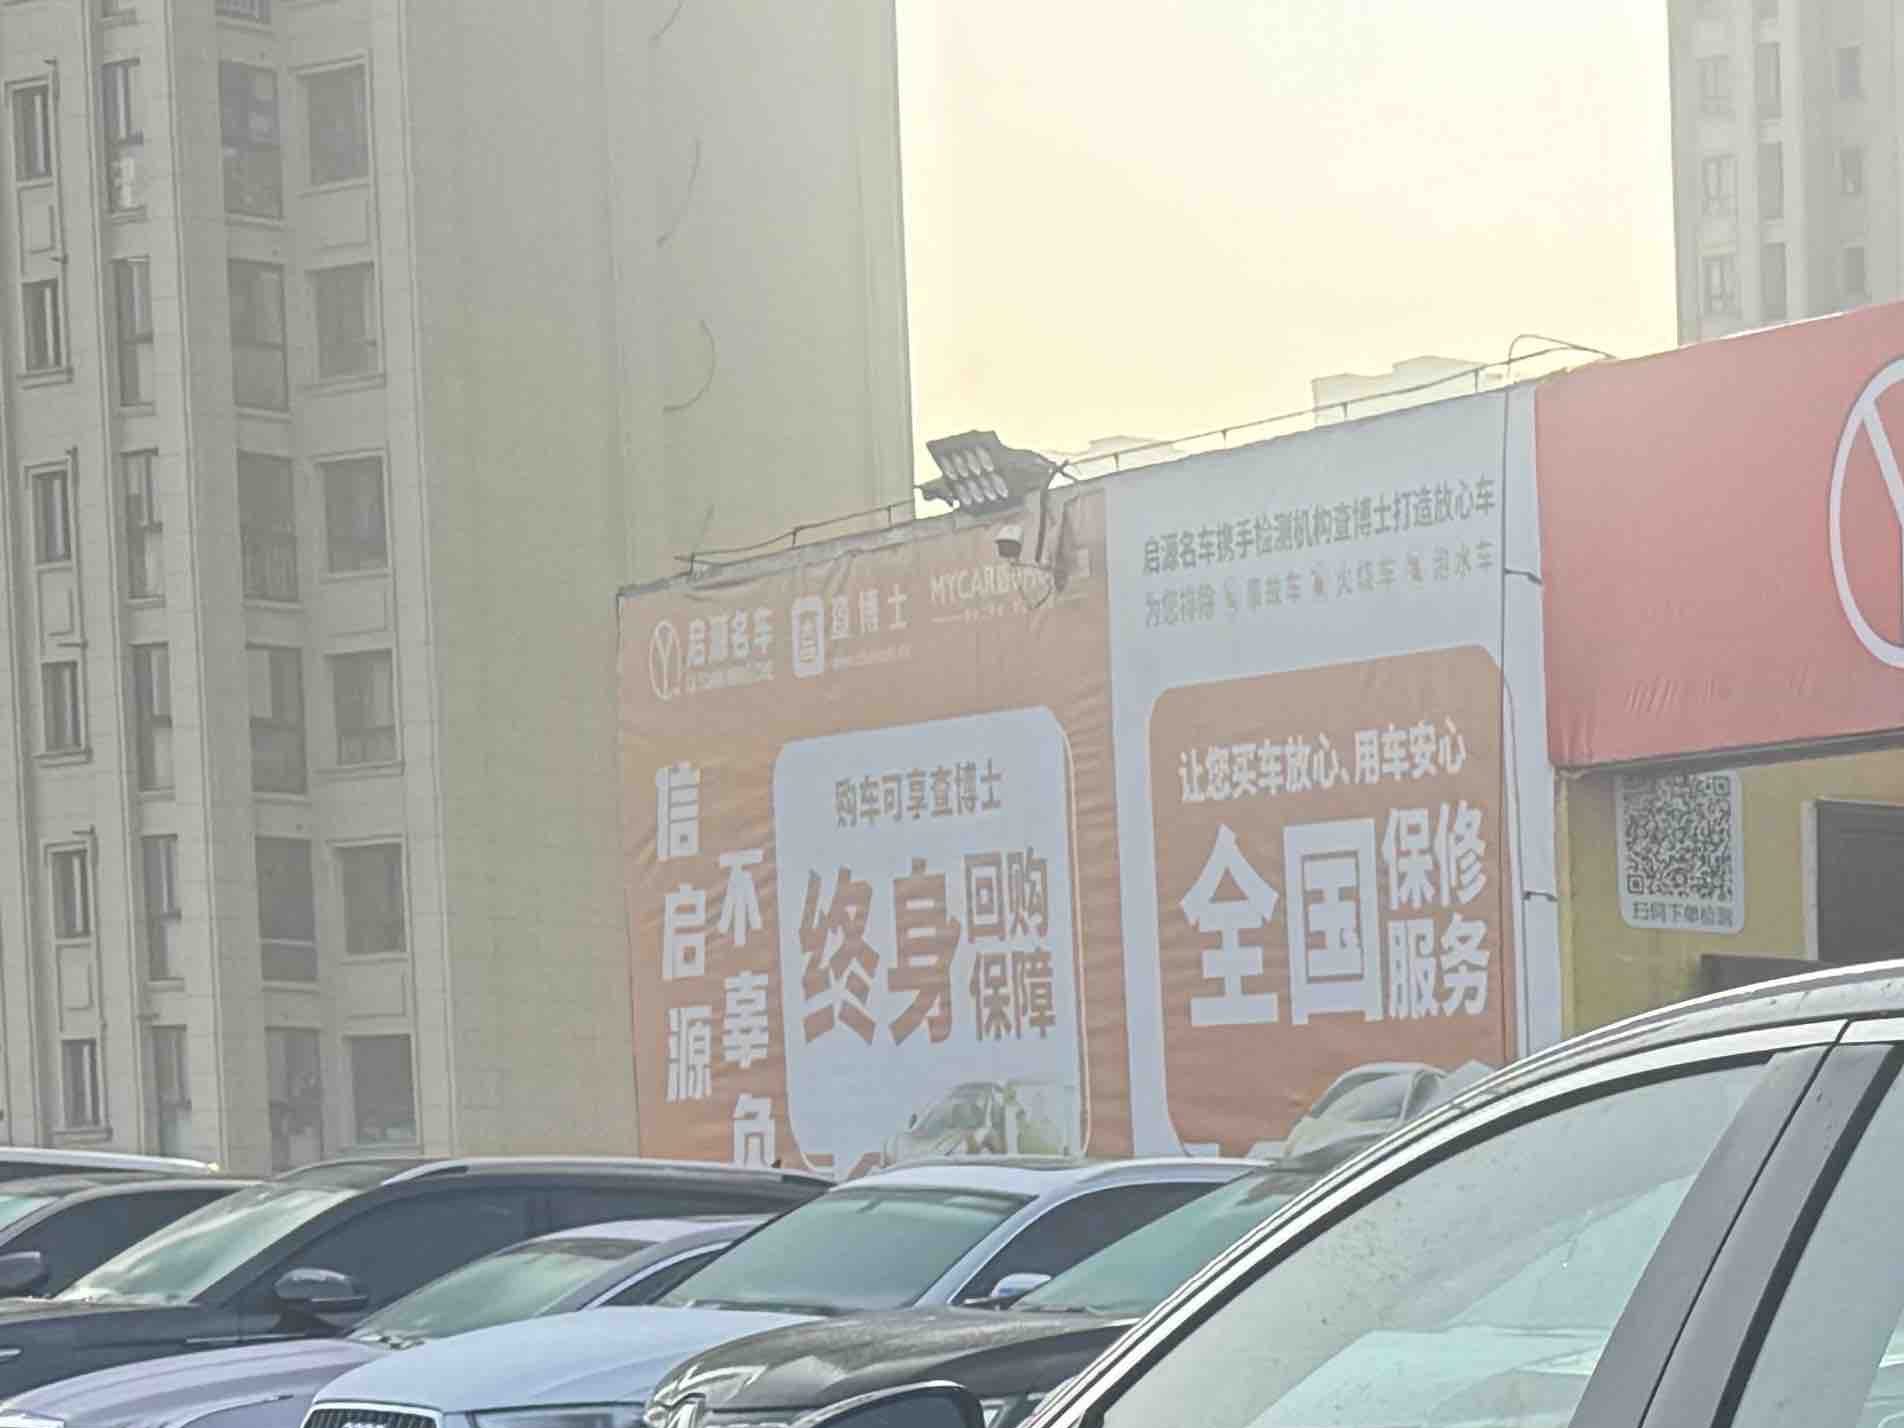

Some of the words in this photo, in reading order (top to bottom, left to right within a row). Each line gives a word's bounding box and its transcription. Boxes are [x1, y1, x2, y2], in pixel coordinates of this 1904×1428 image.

[833, 759, 1003, 829] 购车可享查博士
[1178, 717, 1467, 803] 让您买车放心、用车安心
[963, 846, 1048, 944] 回购
[1382, 800, 1487, 909] 保修
[655, 762, 713, 1104] 信启源
[799, 857, 961, 1046] 终身
[1179, 823, 1383, 1027] 全国
[1386, 912, 1490, 1021] 服务
[969, 947, 1057, 1043] 保障
